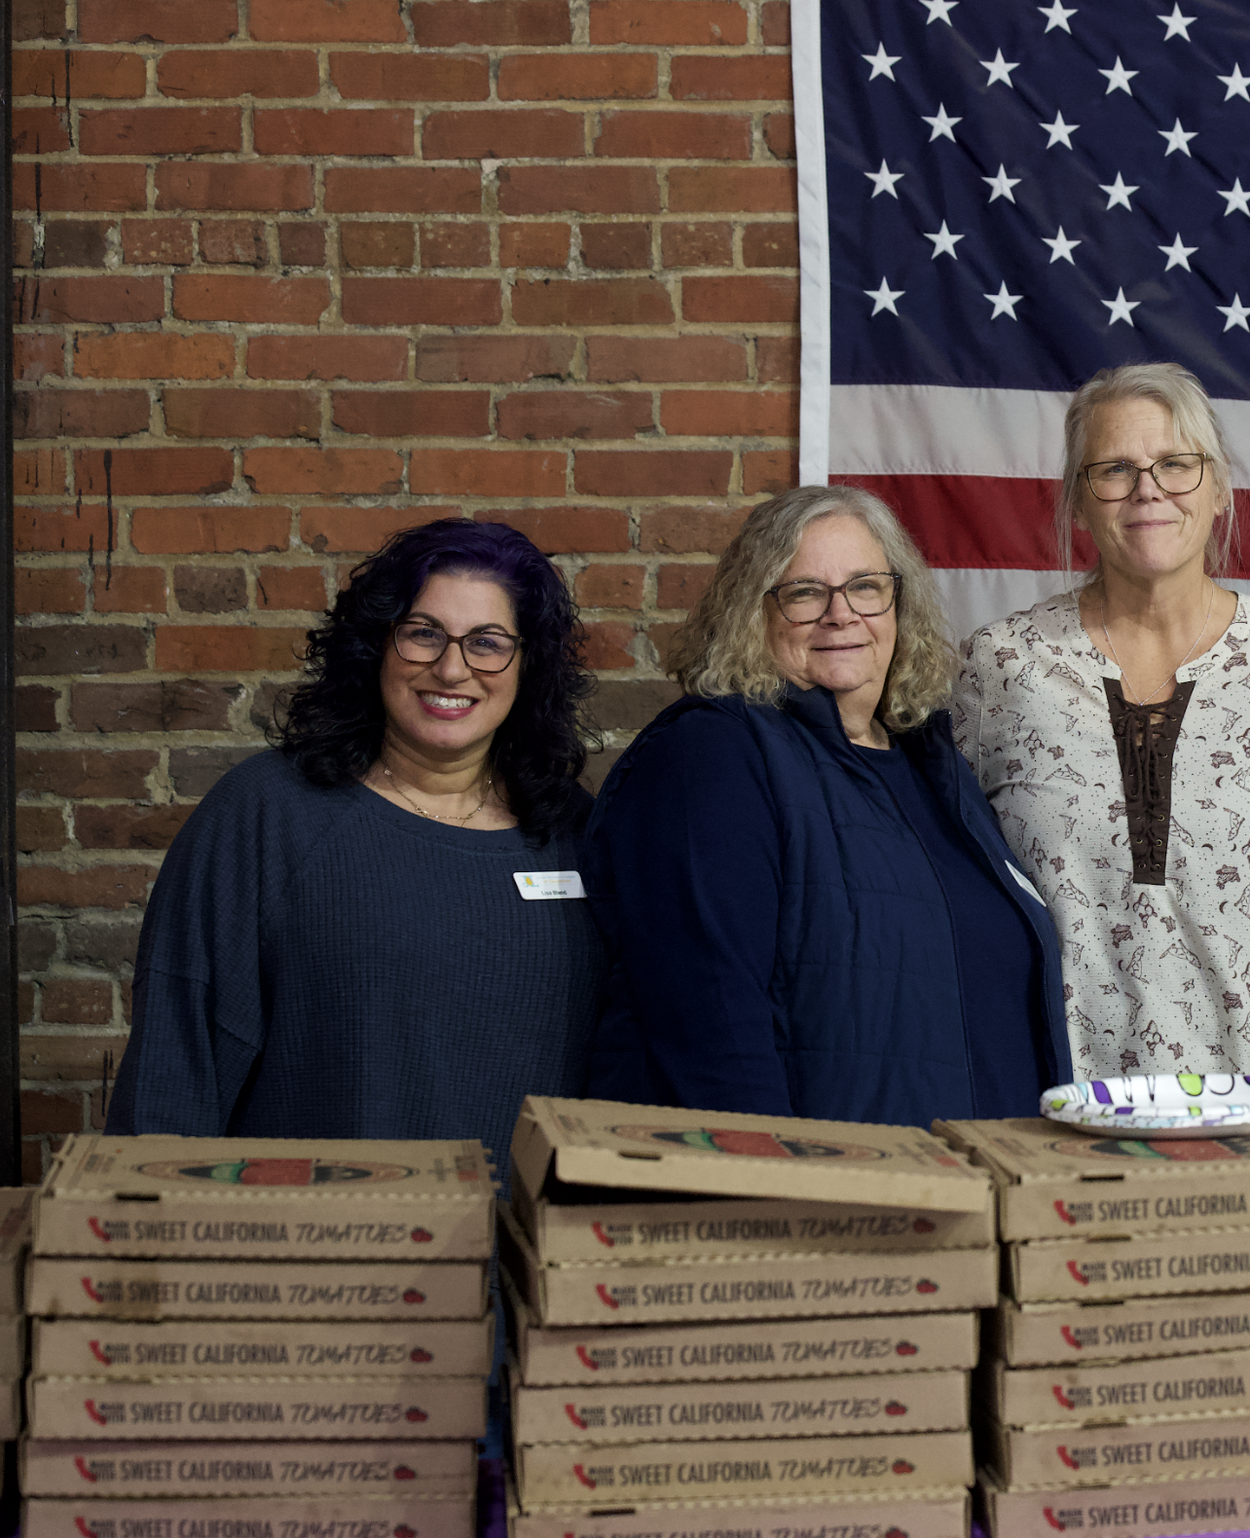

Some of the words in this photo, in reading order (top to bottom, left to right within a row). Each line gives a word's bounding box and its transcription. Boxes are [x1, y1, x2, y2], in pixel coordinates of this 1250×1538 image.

[1098, 1198, 1149, 1222] SWEET
[1155, 1194, 1247, 1219] CALIFORNIA
[134, 1220, 186, 1242] SWEET
[192, 1221, 288, 1242] CALIFORNIA
[296, 1223, 407, 1244] TOMATOES
[639, 1223, 689, 1243] SWEET
[697, 1220, 790, 1240] CALIFORNIA
[798, 1217, 909, 1238] TOMATOES
[1111, 1257, 1162, 1281] SWEET
[127, 1283, 179, 1302] SWEET
[185, 1283, 281, 1304] CALIFORNIA
[289, 1283, 400, 1307] TOMATOES
[642, 1283, 694, 1306] SWEET
[700, 1280, 795, 1304] CALIFORNIA
[802, 1276, 912, 1300] TOMATOES
[1103, 1322, 1153, 1345] SWEET
[1159, 1319, 1250, 1341] CALIFORNIA
[135, 1343, 187, 1365] SWEET
[193, 1344, 289, 1365] CALIFORNIA
[297, 1343, 407, 1364] TOMATOES
[621, 1346, 674, 1368] SWEET
[680, 1343, 775, 1366] CALIFORNIA
[782, 1338, 892, 1362] TOMATOES
[1097, 1382, 1147, 1406] SWEET
[1153, 1376, 1246, 1402] CALIFORNIA
[130, 1402, 182, 1424] SWEET
[188, 1401, 284, 1423] CALIFORNIA
[292, 1403, 402, 1424] TOMATOES
[611, 1404, 663, 1427] SWEET
[669, 1402, 764, 1425] CALIFORNIA
[771, 1398, 880, 1422] TOMATOES
[1102, 1443, 1152, 1466] SWEET
[1158, 1440, 1250, 1462] CALIFORNIA
[120, 1460, 172, 1481] SWEET
[178, 1460, 273, 1482] CALIFORNIA
[281, 1460, 391, 1481] TOMATOES
[619, 1464, 672, 1486] SWEET
[677, 1461, 772, 1484] CALIFORNIA
[779, 1456, 888, 1480] TOMATOES
[1088, 1504, 1139, 1528] SWEET
[1145, 1498, 1238, 1523] CALIFORNIA
